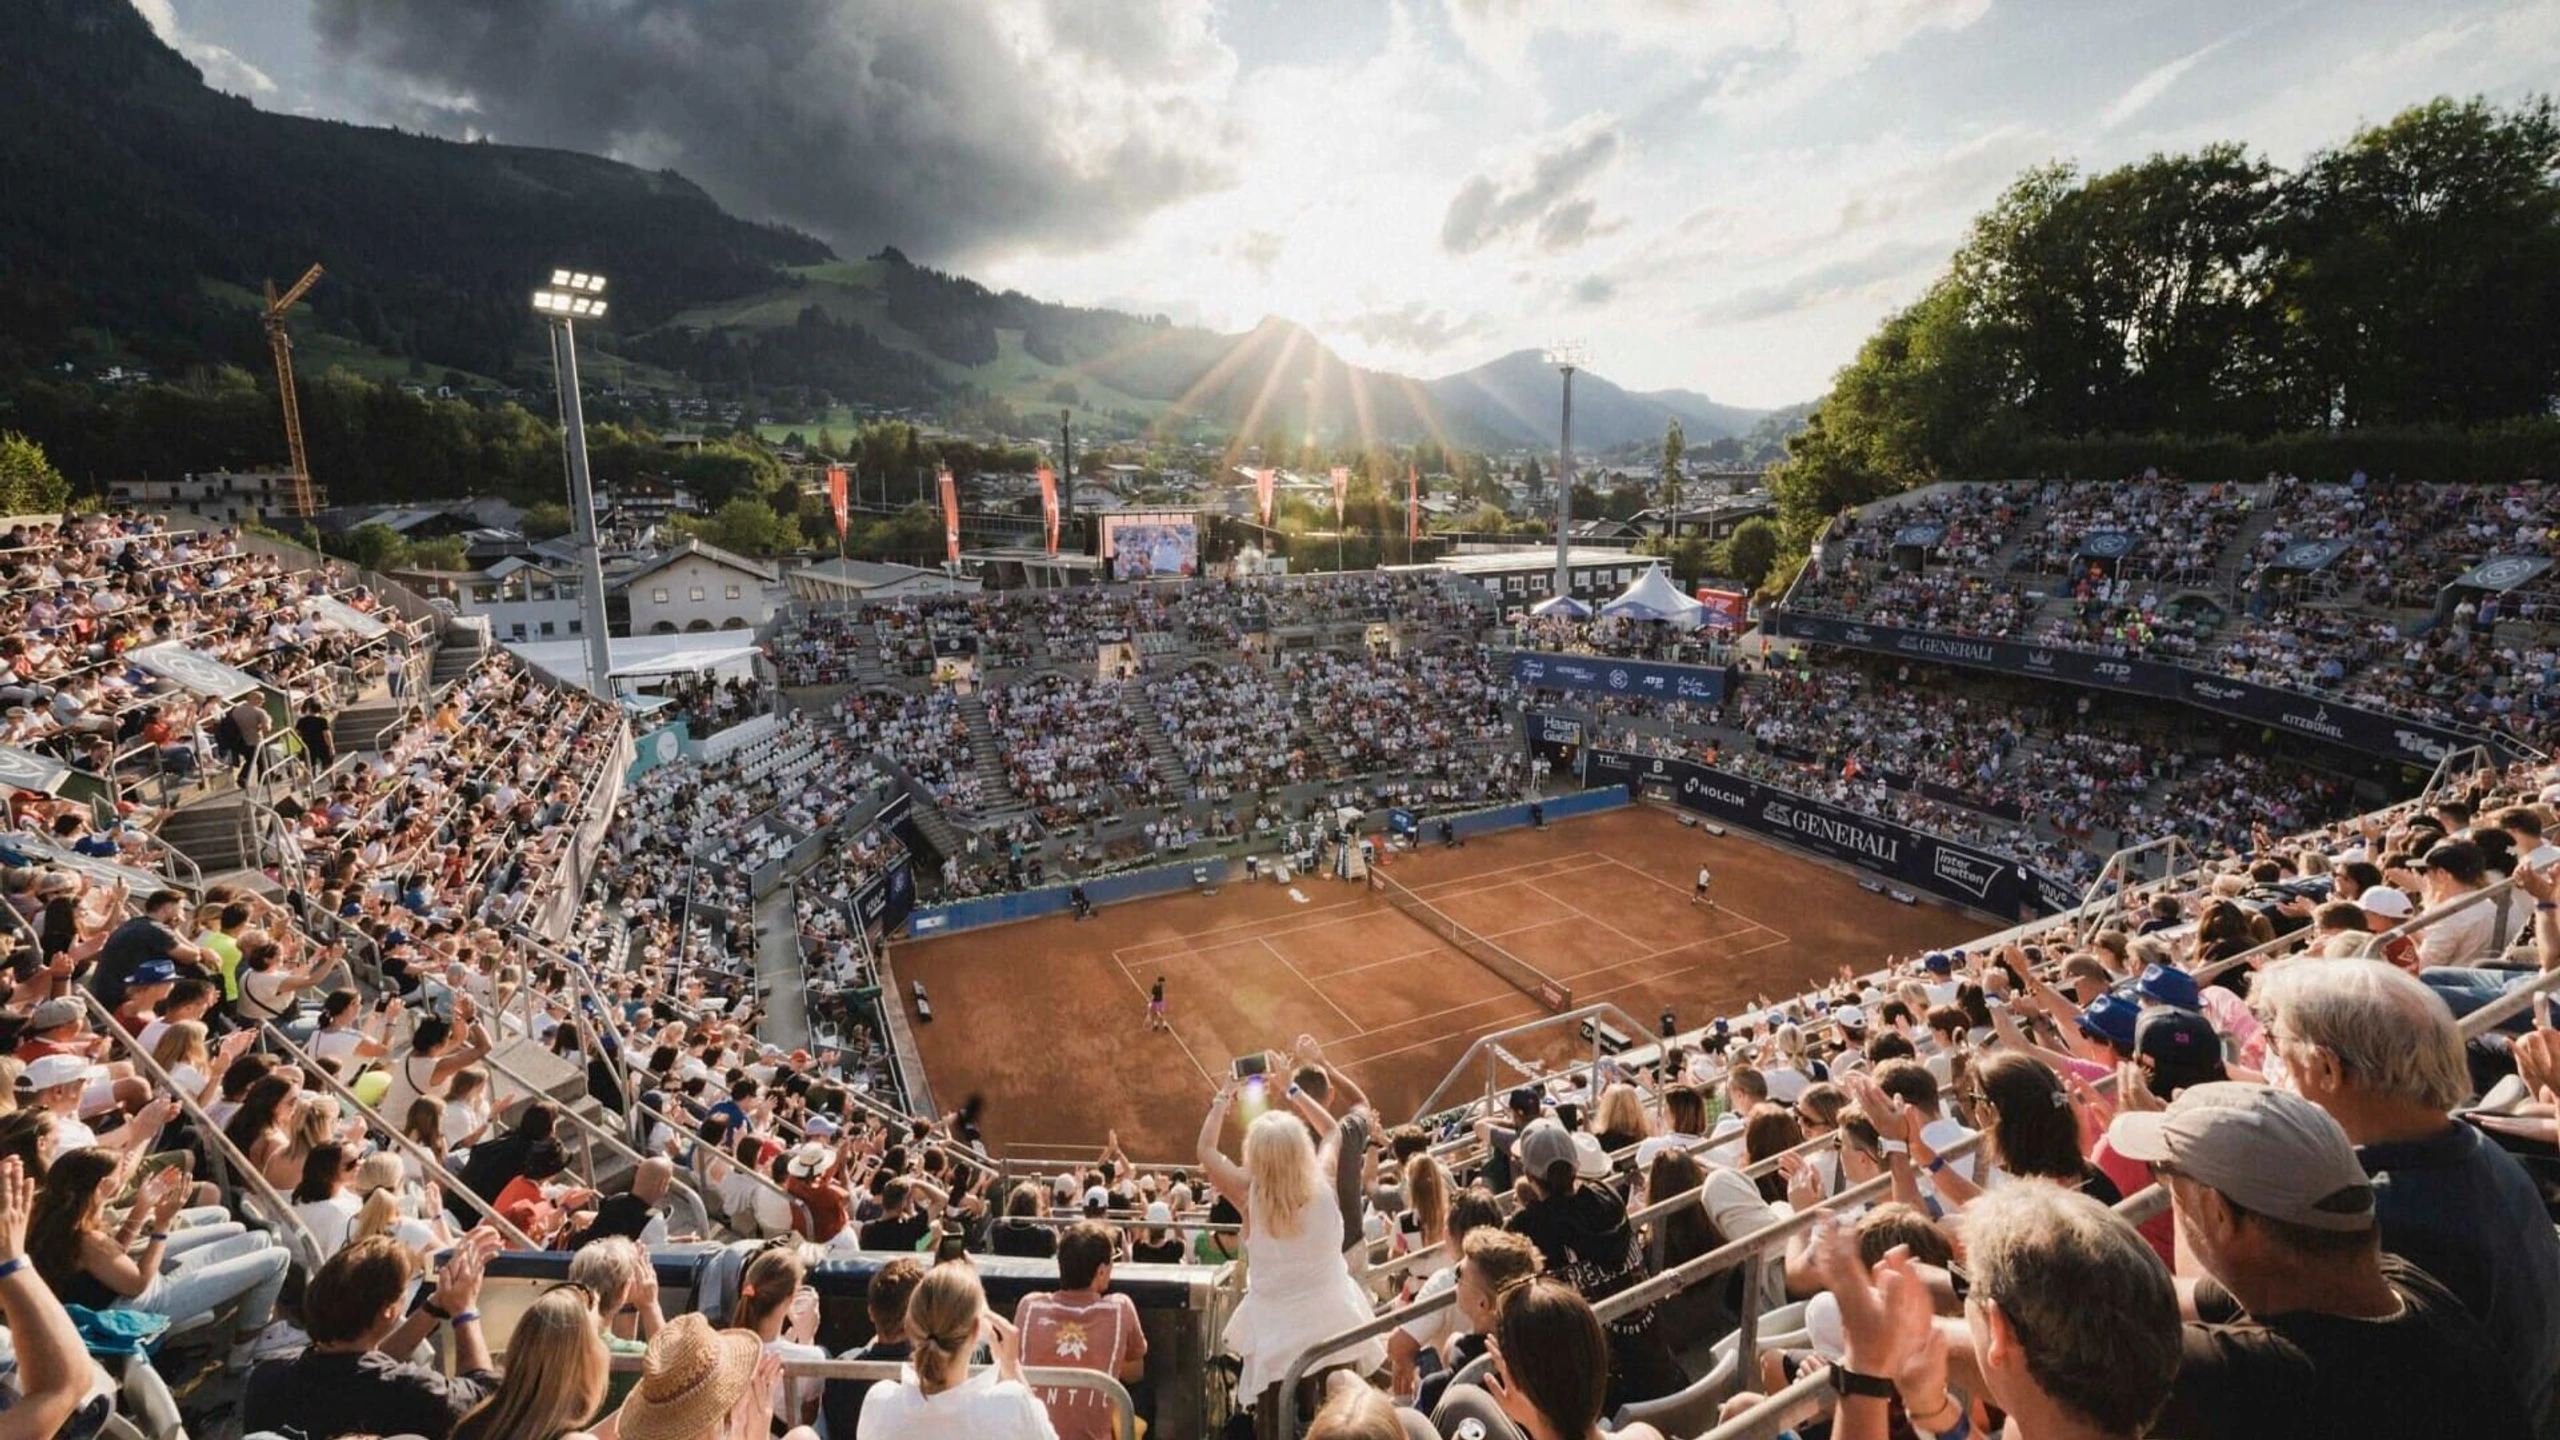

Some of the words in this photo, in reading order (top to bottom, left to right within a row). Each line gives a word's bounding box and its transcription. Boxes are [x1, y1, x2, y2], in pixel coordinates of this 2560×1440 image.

[1919, 638, 1993, 662] GENERALI
[1700, 783, 1745, 807] HOLCIM
[1792, 809, 1900, 862] GENERALI
[1939, 850, 1971, 869] inter
